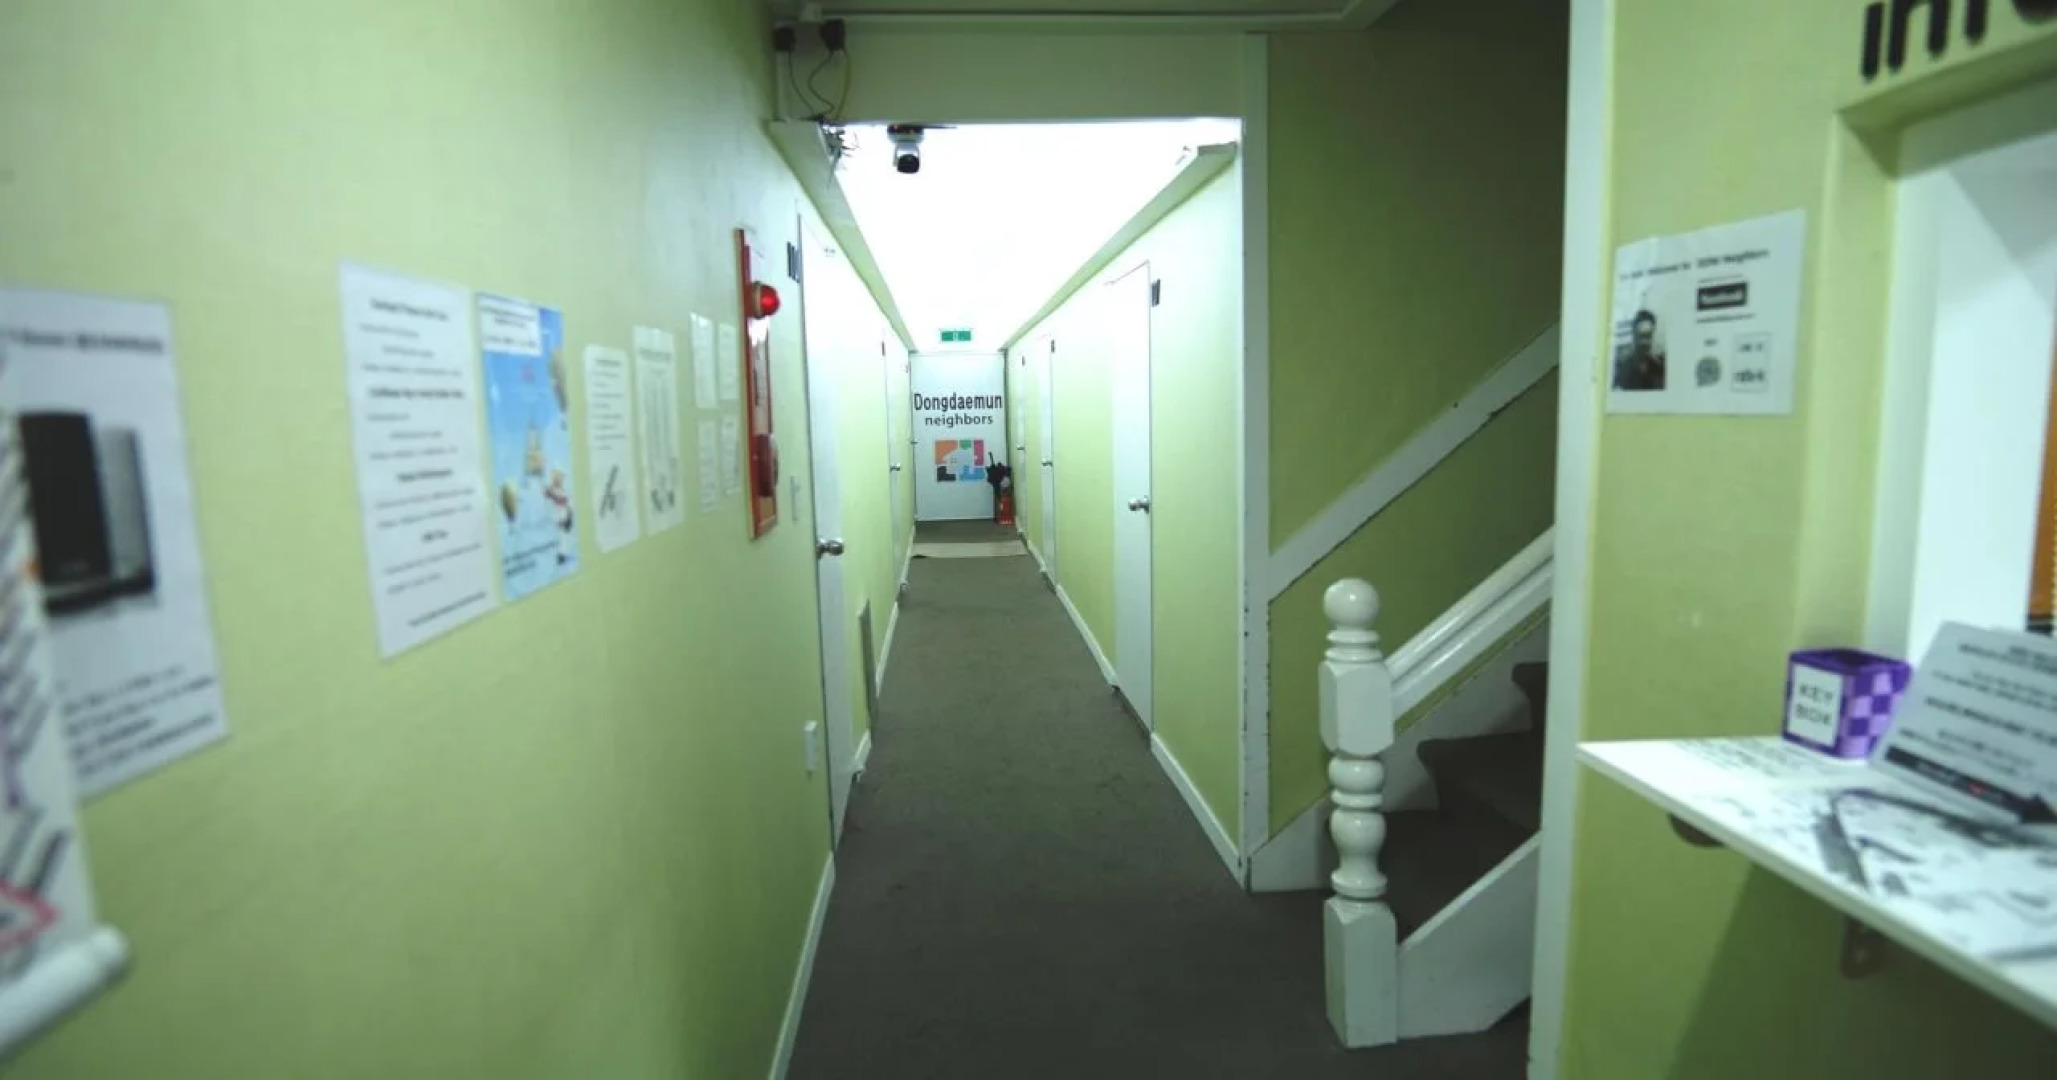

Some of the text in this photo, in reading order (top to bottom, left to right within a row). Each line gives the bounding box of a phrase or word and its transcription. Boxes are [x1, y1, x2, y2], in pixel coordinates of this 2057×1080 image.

[1860, 0, 2057, 84] in
[913, 392, 1003, 412] Dongdaemun
[925, 413, 994, 428] neighbors
[1799, 683, 1833, 702] KEY
[1795, 703, 1832, 725] BOX
